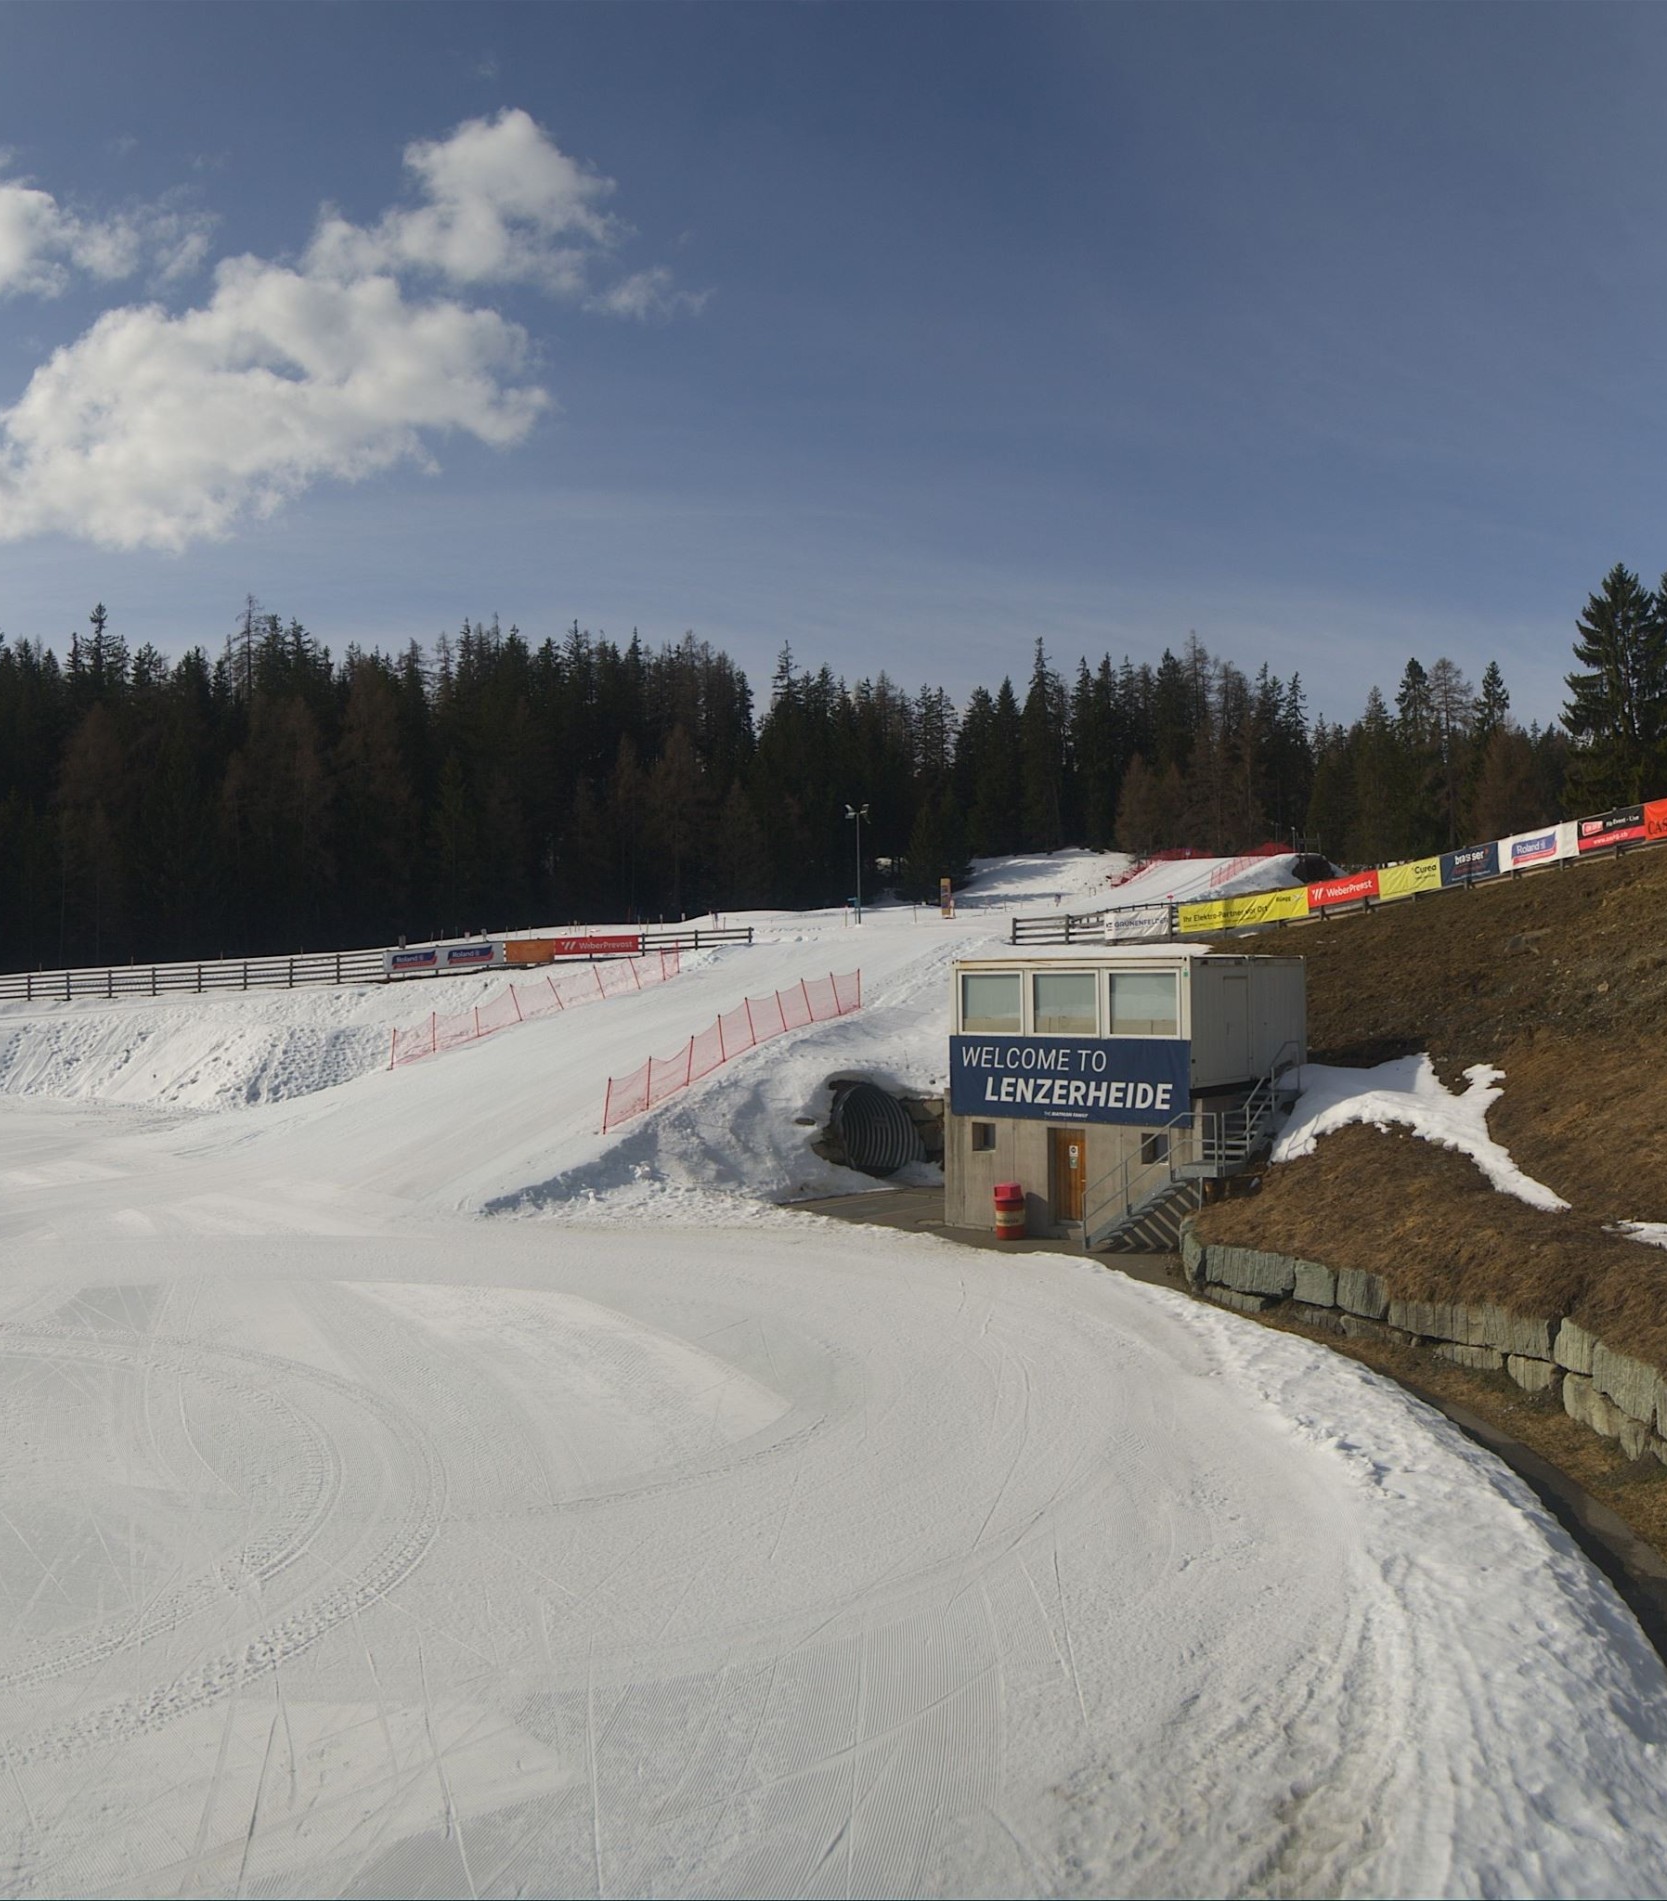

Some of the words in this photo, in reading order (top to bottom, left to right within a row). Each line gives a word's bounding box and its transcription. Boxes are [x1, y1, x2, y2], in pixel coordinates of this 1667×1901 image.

[1517, 841, 1540, 855] Roland
[578, 941, 633, 949] WeberPrevost
[396, 955, 418, 963] Roland
[452, 950, 474, 959] Roland
[962, 1047, 1070, 1071] WELCOME
[1078, 1050, 1107, 1072] TO
[984, 1076, 1173, 1110] LENZERHEIDE
